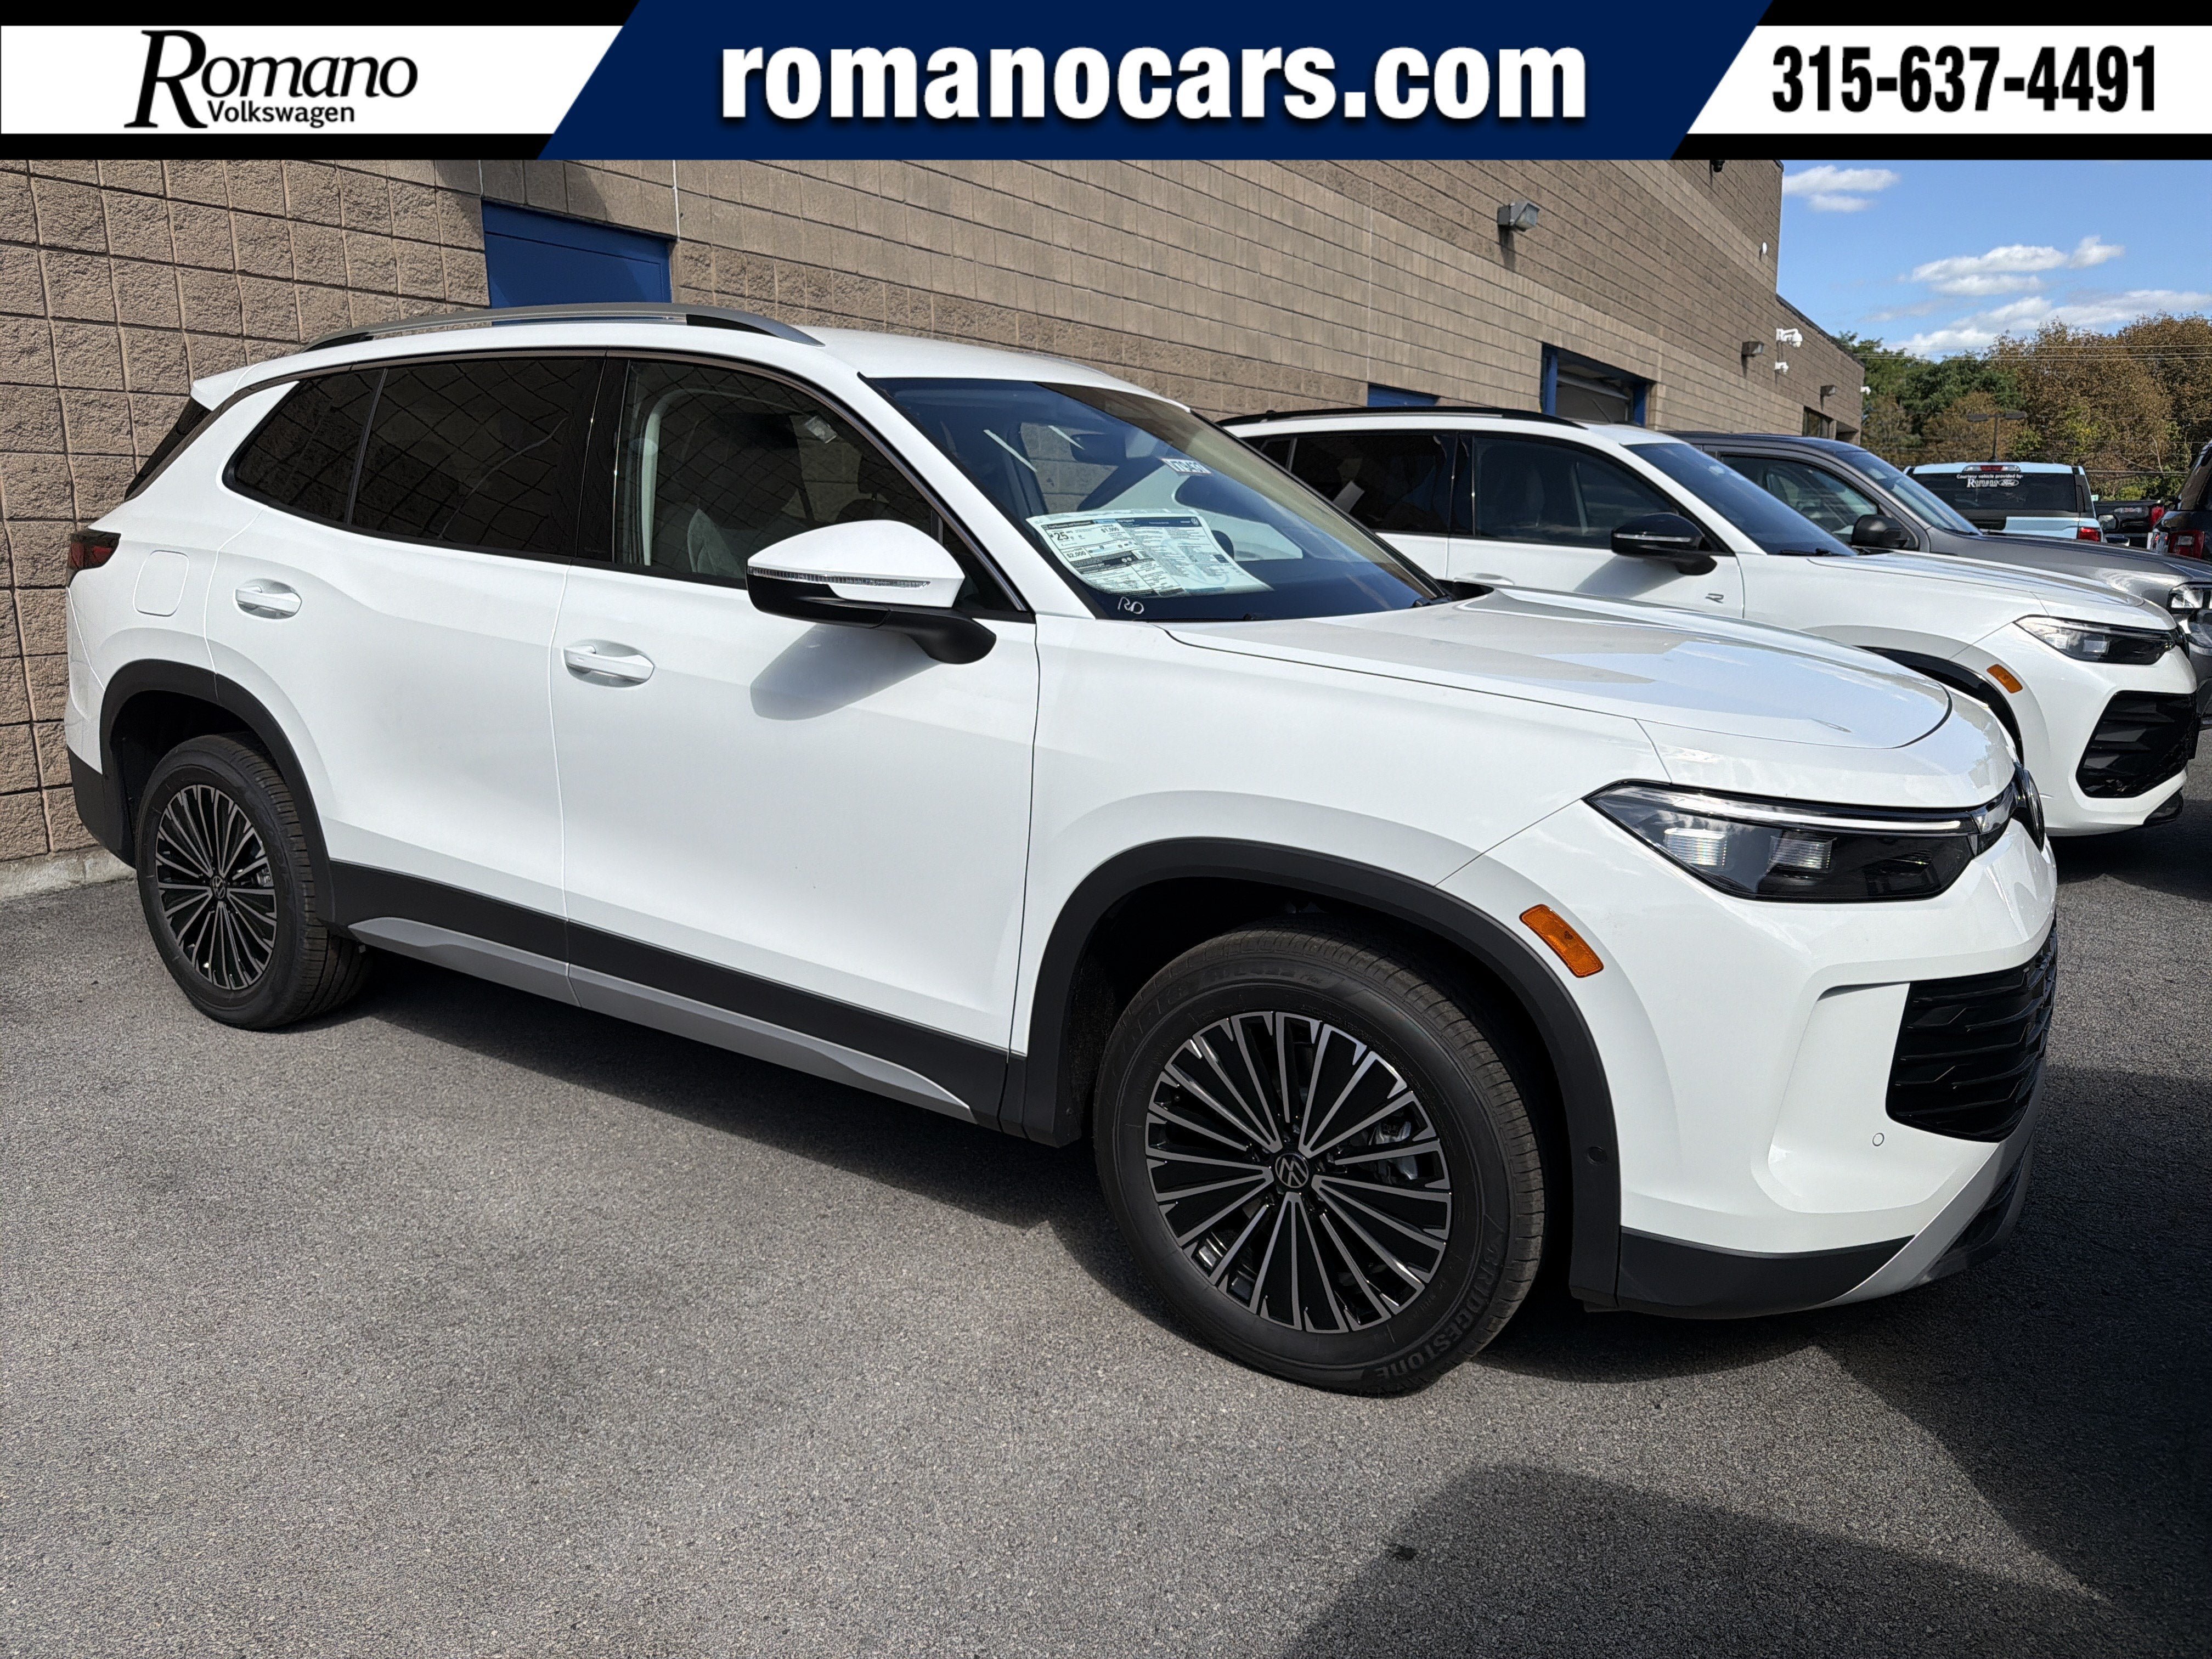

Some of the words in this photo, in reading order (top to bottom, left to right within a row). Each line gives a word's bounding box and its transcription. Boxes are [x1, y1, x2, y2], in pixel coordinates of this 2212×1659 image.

[1967, 478, 1999, 488] Romano
[1054, 531, 1069, 541] 25
[1377, 1244, 1504, 1380] BRIDGESTONE
